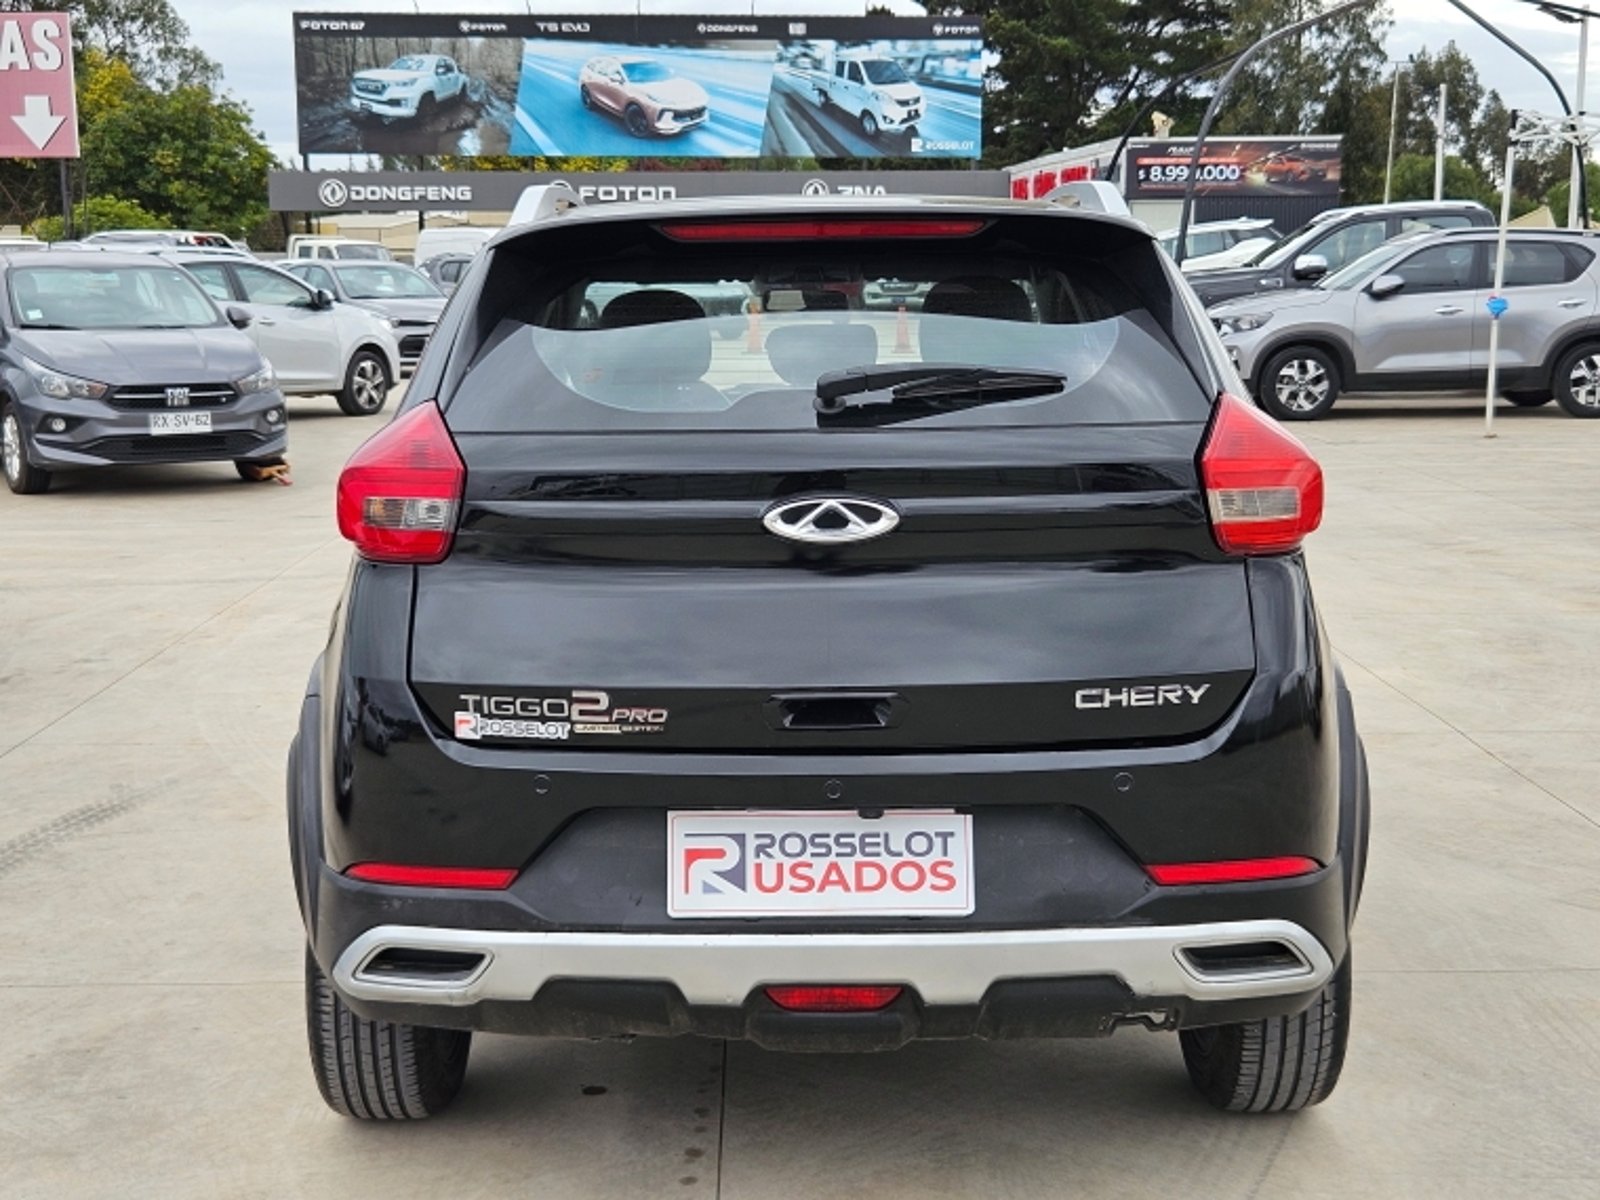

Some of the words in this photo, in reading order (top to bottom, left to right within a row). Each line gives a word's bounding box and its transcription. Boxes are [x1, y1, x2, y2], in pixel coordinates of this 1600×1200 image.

[299, 20, 348, 31] FOTON
[945, 25, 980, 34] FOTON
[1149, 165, 1240, 181] 8.99.000
[350, 185, 472, 201] DONGFENG
[578, 185, 677, 200] FOTON
[1075, 684, 1211, 709] CHERY
[459, 694, 570, 717] TIGGO
[611, 708, 668, 723] PRO
[479, 720, 570, 738] ROSSELOT
[754, 831, 955, 859] ROSSELOT
[754, 860, 956, 895] USADOS
